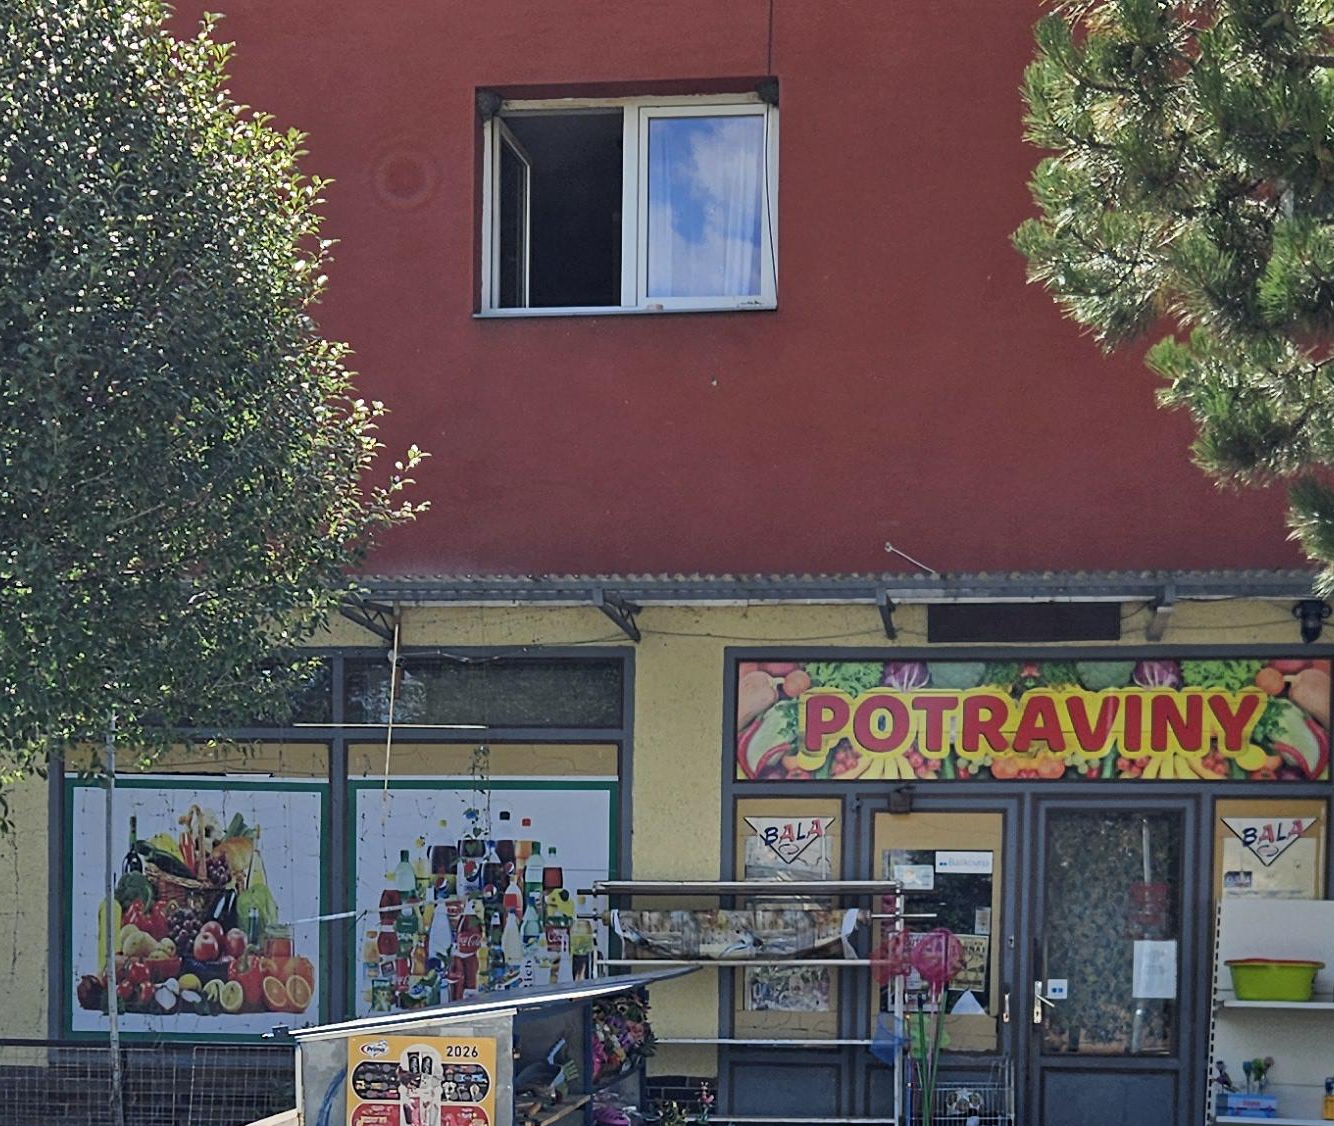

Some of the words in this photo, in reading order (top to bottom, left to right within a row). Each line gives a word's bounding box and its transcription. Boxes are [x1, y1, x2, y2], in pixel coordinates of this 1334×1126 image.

[804, 694, 1260, 753] POTRAVINY
[764, 819, 824, 846] BALA
[1242, 819, 1307, 847] BALA
[446, 1046, 479, 1058] 2026
